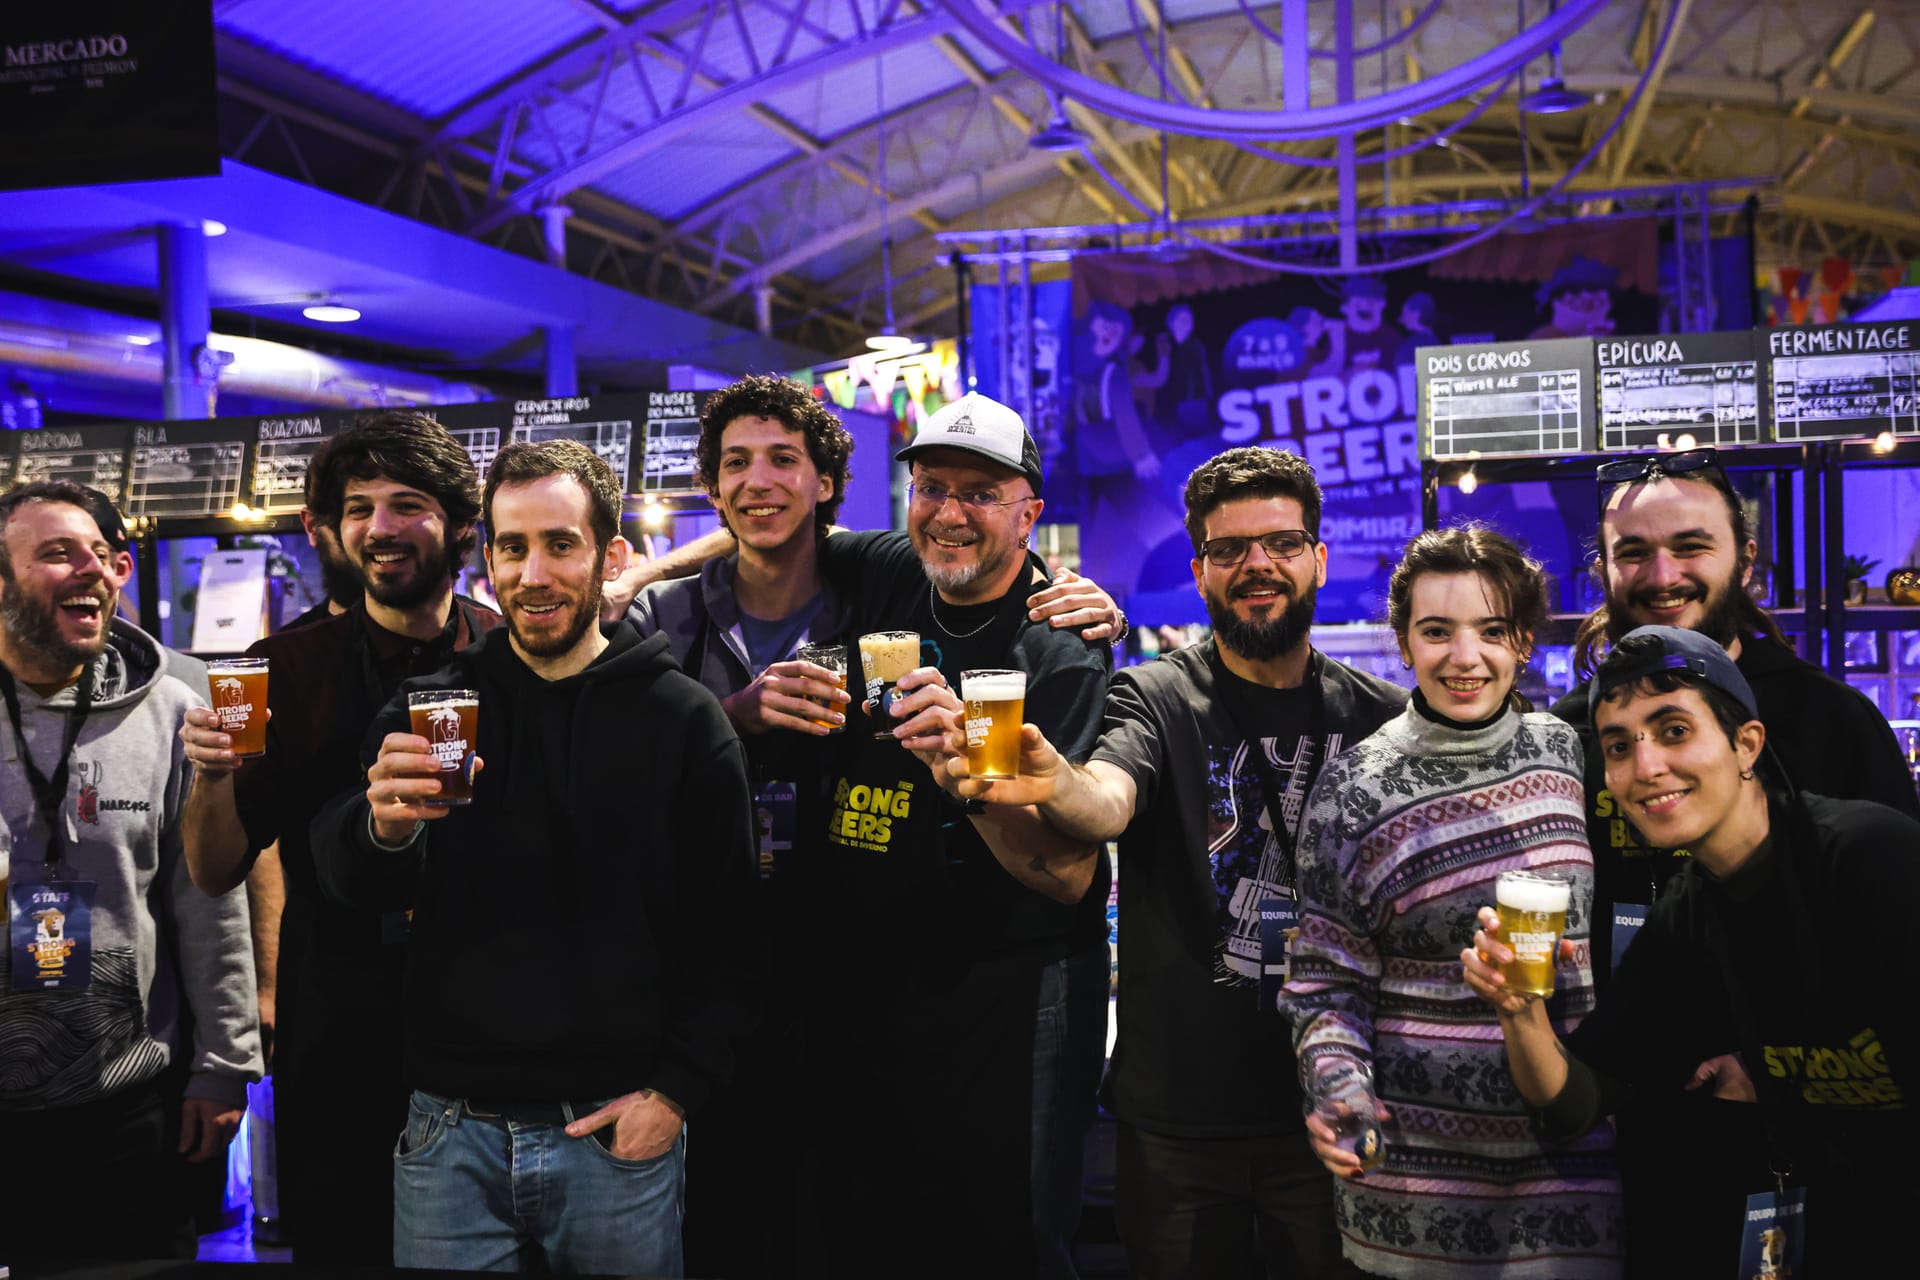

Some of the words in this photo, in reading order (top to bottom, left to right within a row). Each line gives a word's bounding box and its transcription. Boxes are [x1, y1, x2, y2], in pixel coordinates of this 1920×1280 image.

[5, 33, 129, 67] MERCADO
[1770, 326, 1911, 356] FERMENTAGE
[1428, 355, 1463, 375] DOIS
[1466, 349, 1532, 372] CORVOS
[1262, 420, 1422, 487] EER
[216, 703, 253, 717] STRONG
[32, 892, 71, 904] STAFF
[1261, 911, 1294, 921] EQUIPA
[1615, 915, 1646, 927] EQUIP
[27, 938, 77, 953] STRONG
